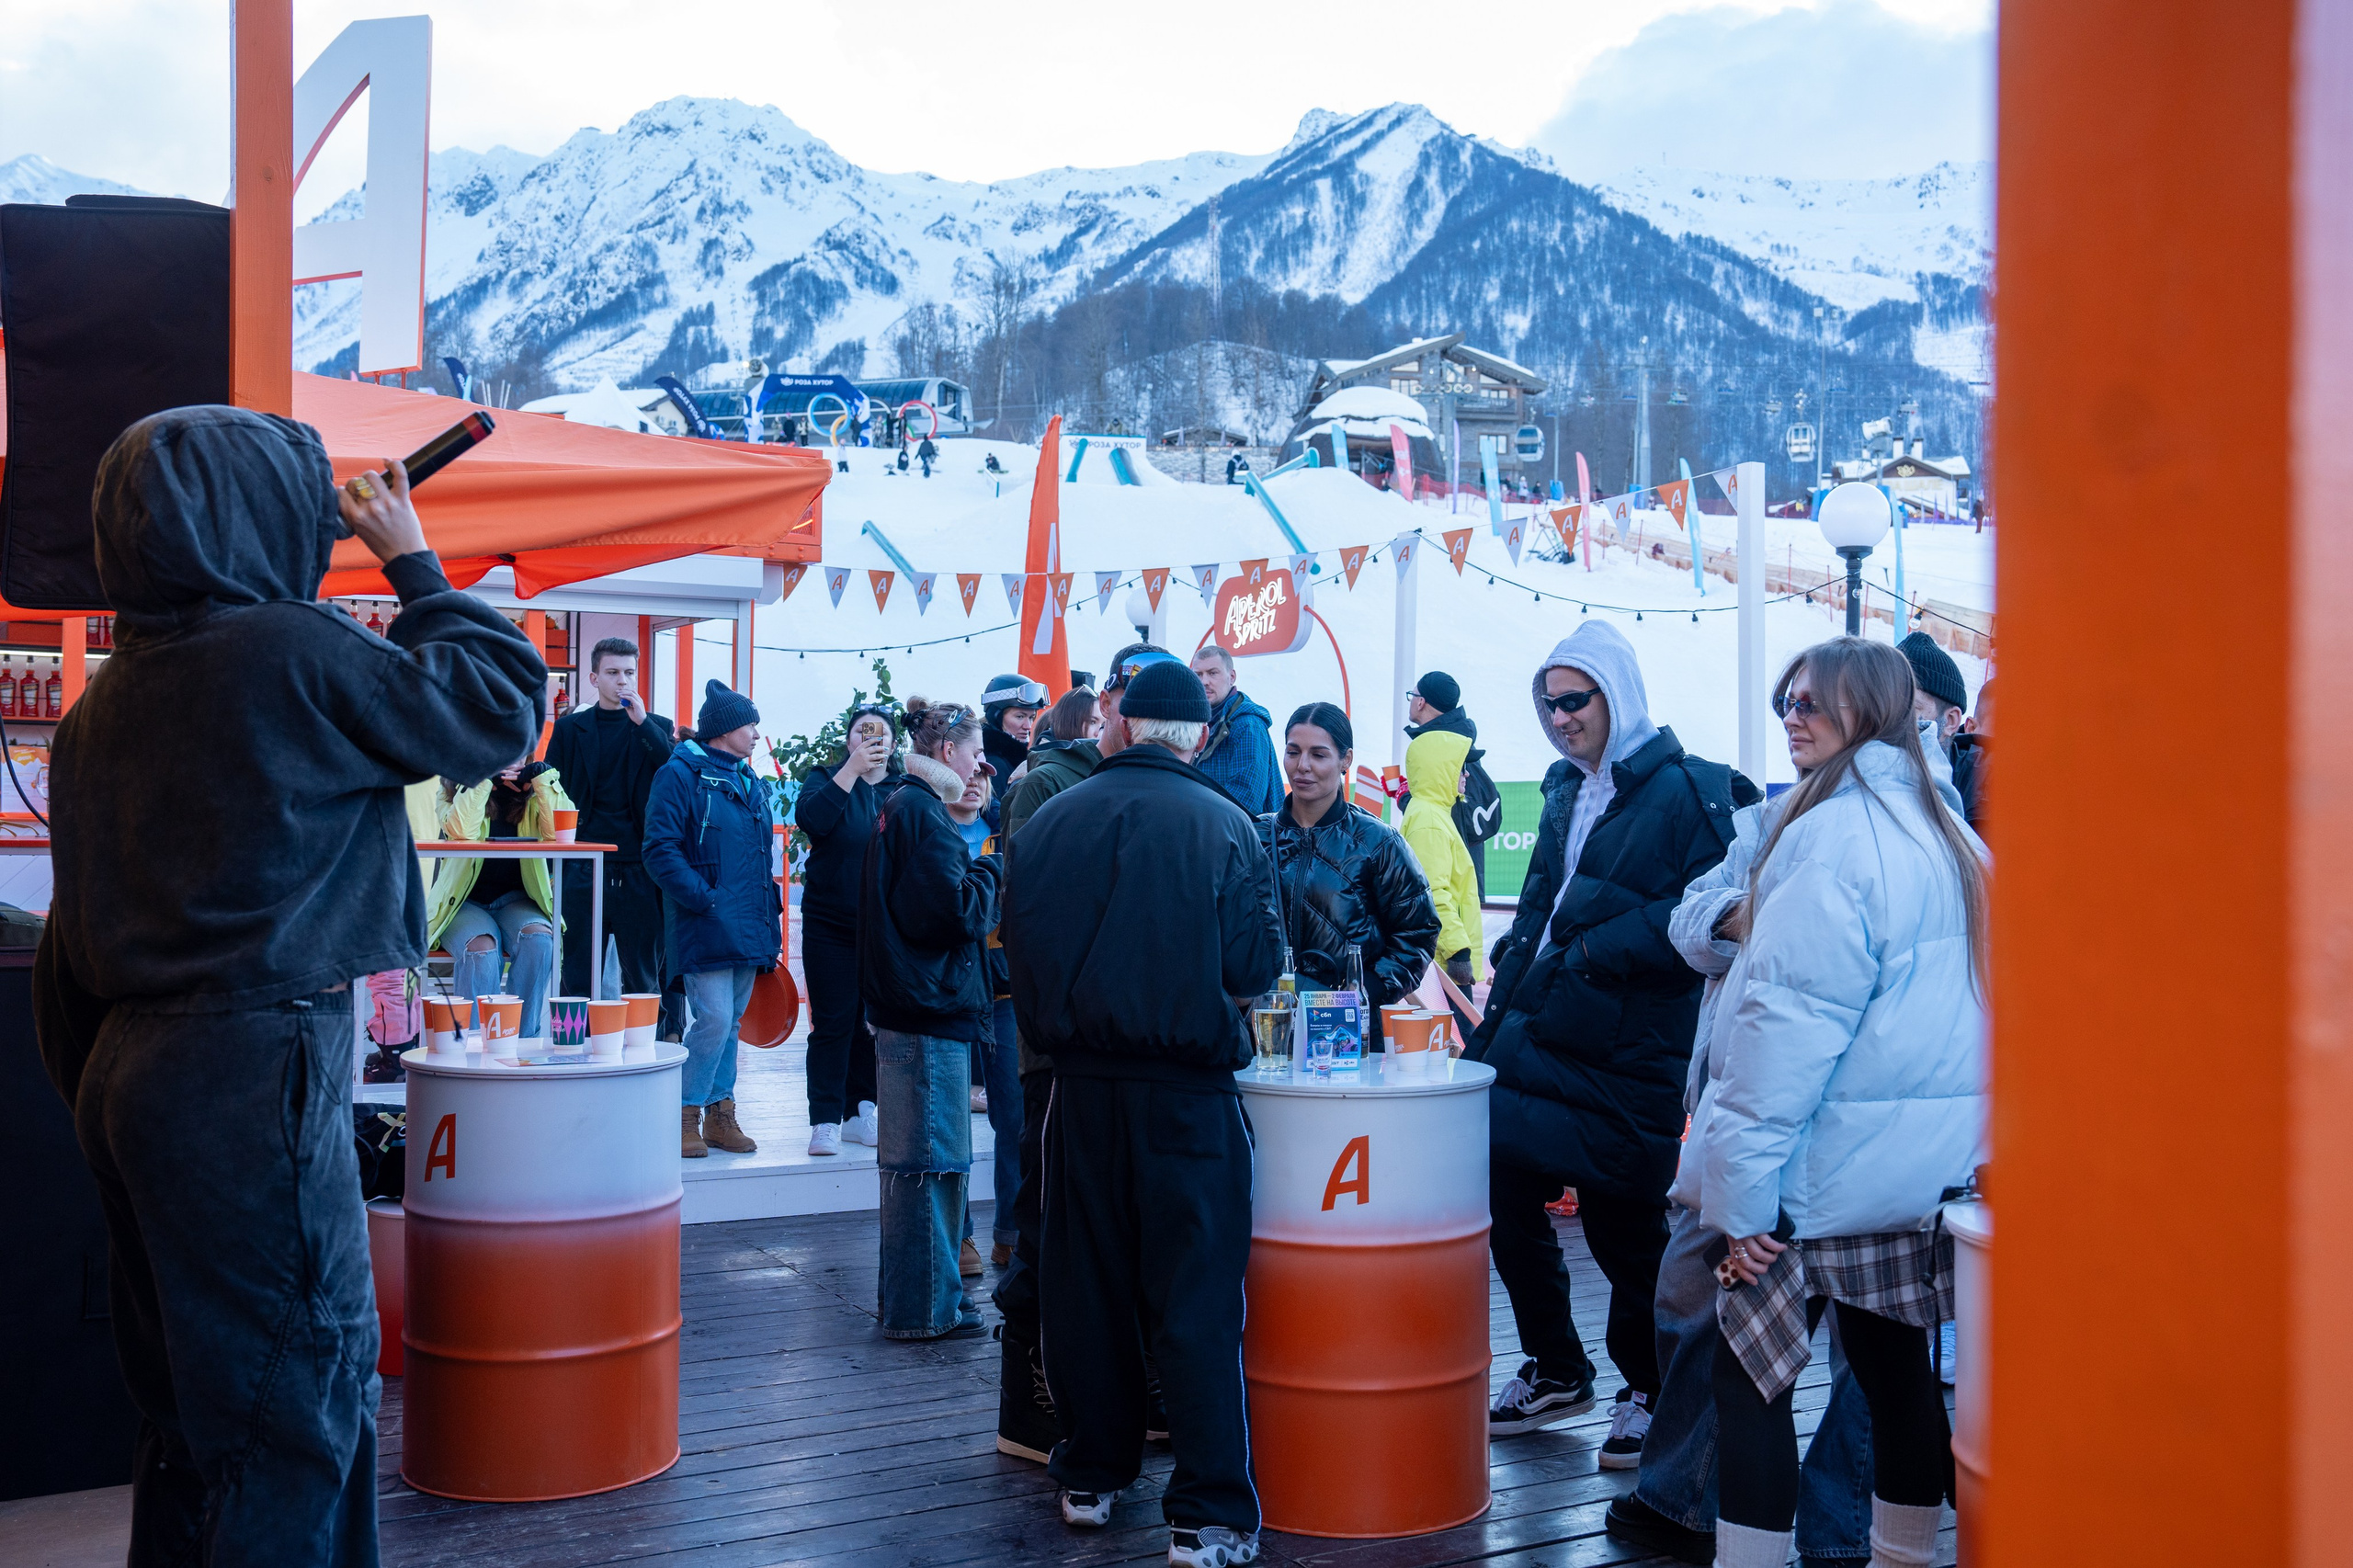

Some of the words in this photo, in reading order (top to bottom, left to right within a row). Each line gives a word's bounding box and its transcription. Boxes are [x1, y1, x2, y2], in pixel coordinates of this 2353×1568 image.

[1671, 489, 1682, 509] A
[1616, 502, 1626, 519] A
[1563, 515, 1573, 533] A
[1508, 527, 1520, 545] A
[1398, 546, 1409, 562] A
[1453, 537, 1464, 554] A
[1295, 559, 1306, 574] A
[1347, 552, 1359, 571] A
[786, 568, 798, 582] A
[832, 574, 842, 590] A
[1201, 569, 1212, 586] A
[1250, 566, 1261, 585] A
[876, 578, 887, 594] A
[919, 580, 928, 596] A
[963, 580, 974, 597] A
[1010, 580, 1019, 597] A
[1057, 578, 1068, 596] A
[1101, 578, 1112, 593] A
[1150, 576, 1161, 592] A
[1223, 577, 1286, 635] APEROL
[1336, 998, 1357, 1006] ВЫСОТЕ
[486, 1012, 501, 1039] A
[1428, 1023, 1444, 1051] A
[424, 1113, 456, 1182] A
[1321, 1134, 1370, 1212] A
